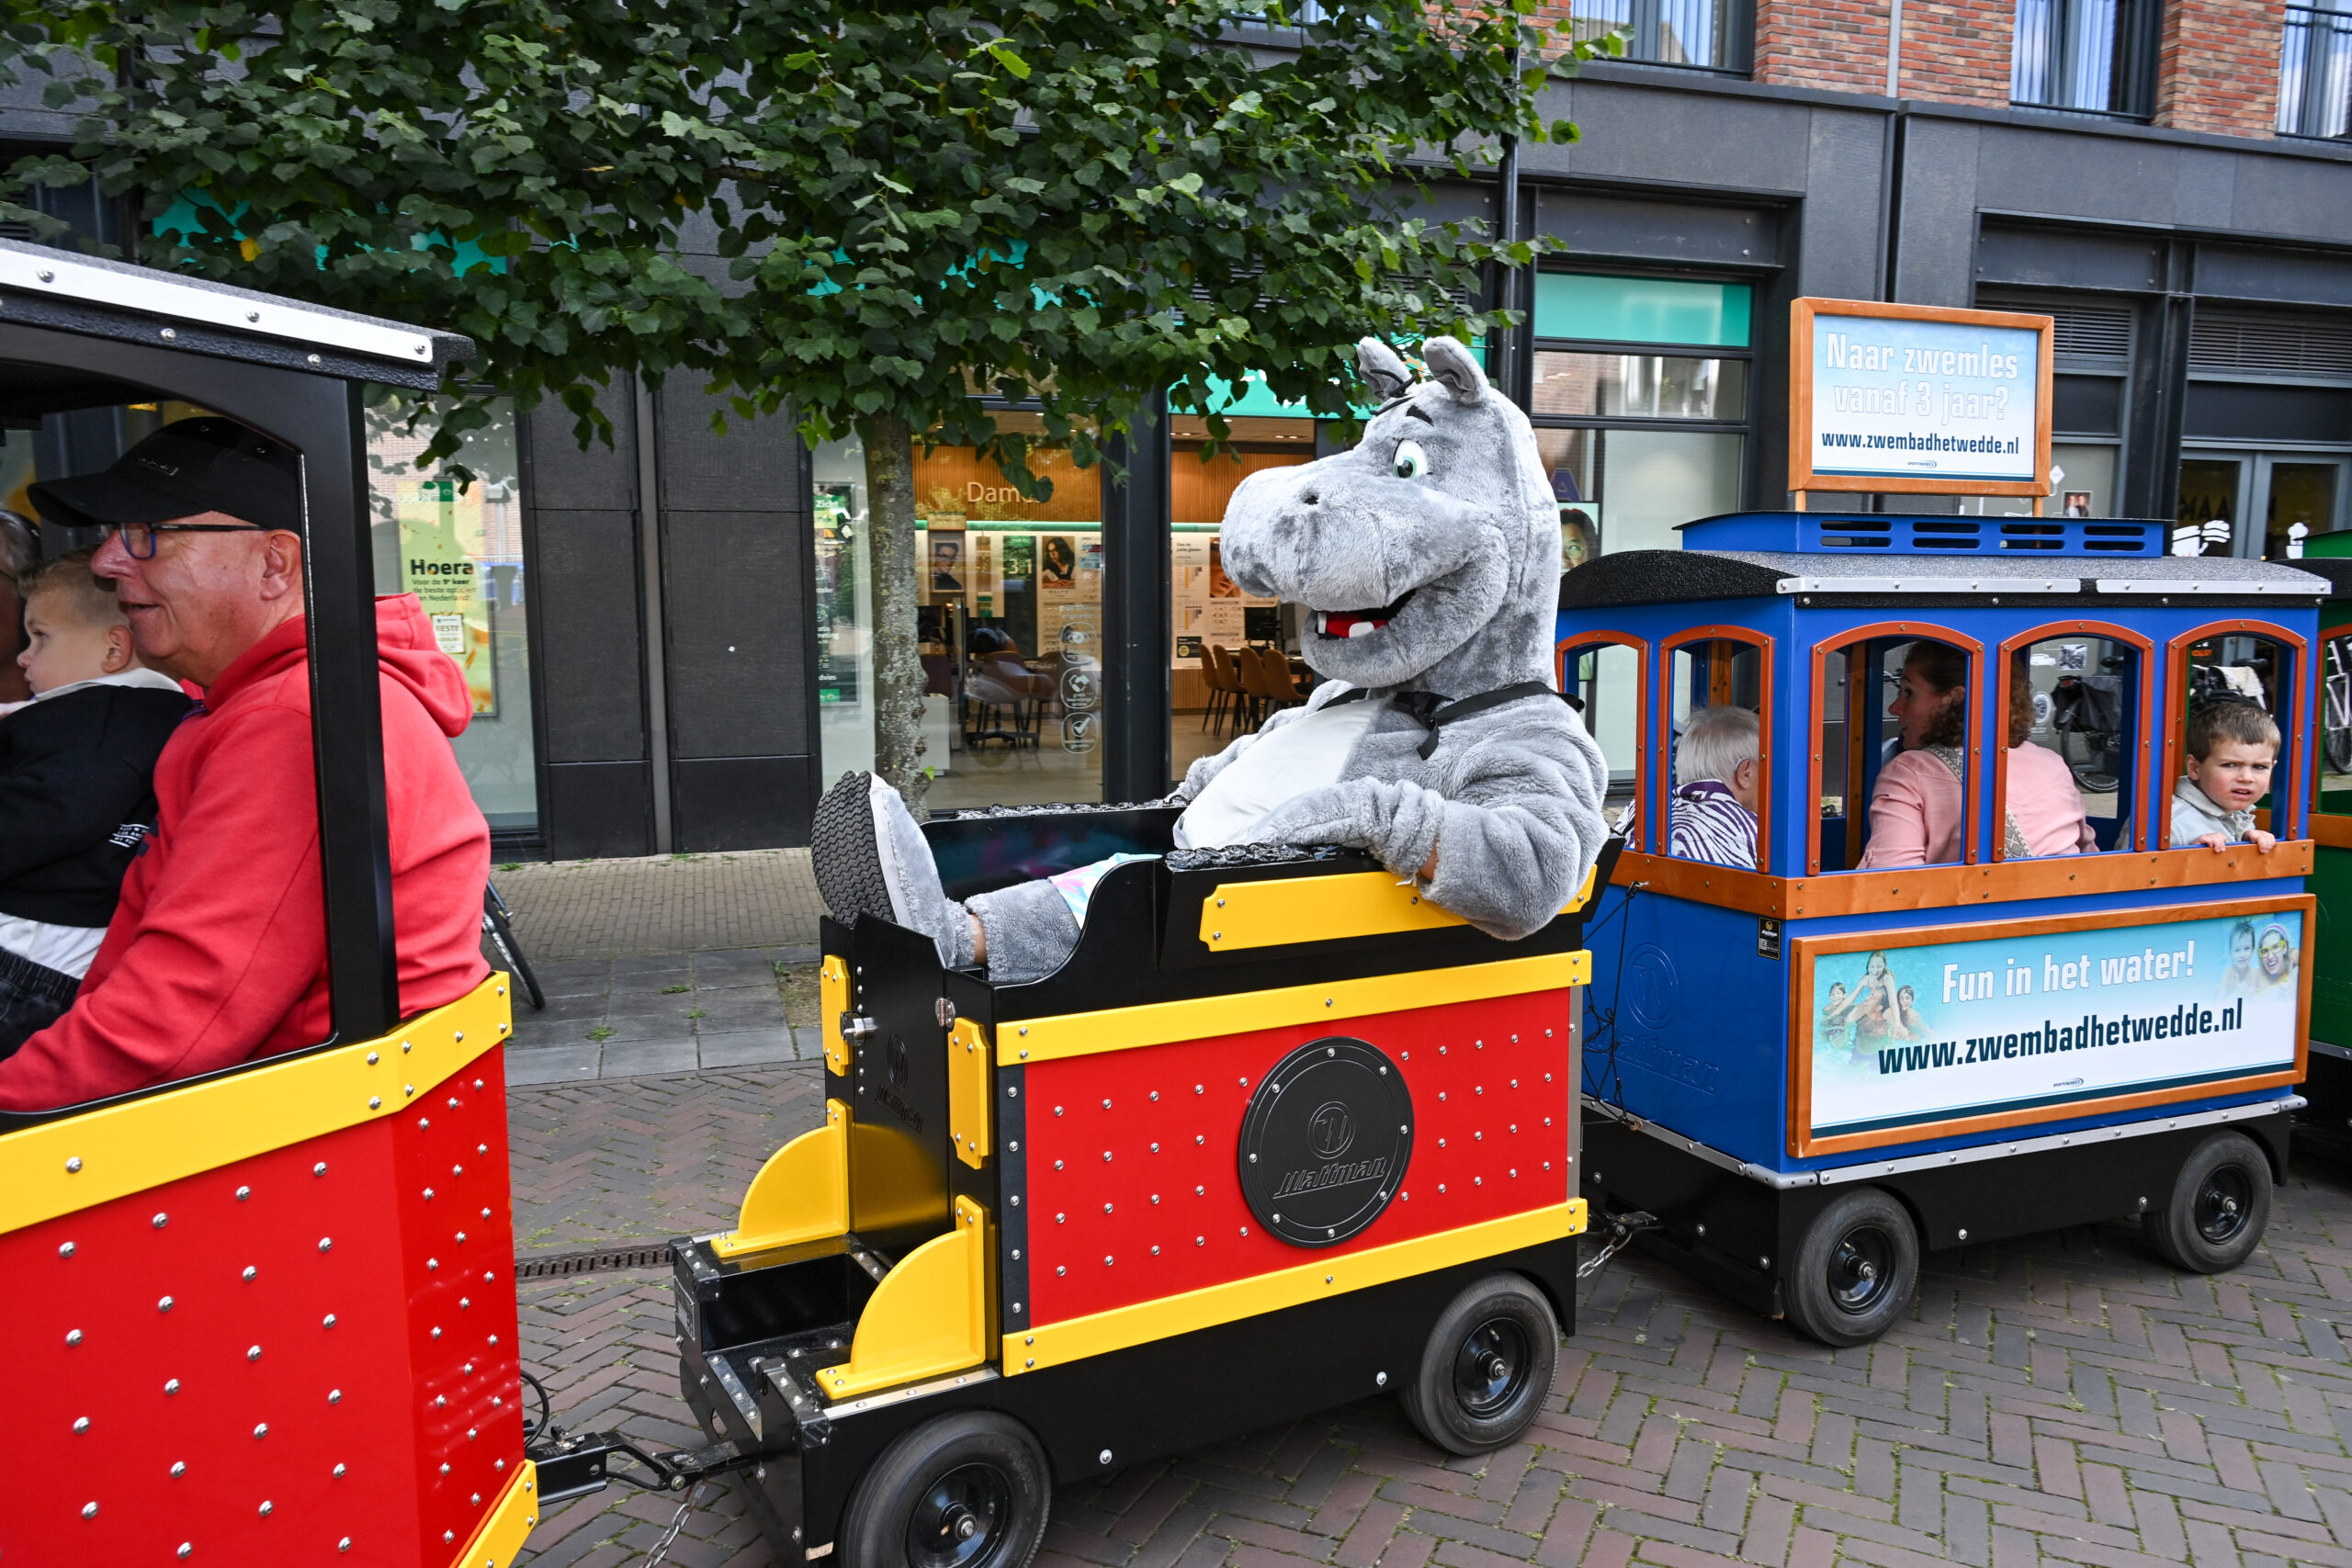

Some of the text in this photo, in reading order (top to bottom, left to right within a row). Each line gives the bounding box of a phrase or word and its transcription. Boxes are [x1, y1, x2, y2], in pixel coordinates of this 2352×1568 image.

[1826, 332, 2018, 379] Naar zwemles
[1834, 378, 2008, 425] vanaf 3 jaar?
[1822, 432, 2019, 454] www.zwembadhetwedde.nl
[967, 481, 1041, 502] Dam
[410, 558, 474, 575] Hoera
[1941, 940, 2195, 1004] Fun in het water!
[1878, 998, 2244, 1075] www.zwembadhetwedde.nl
